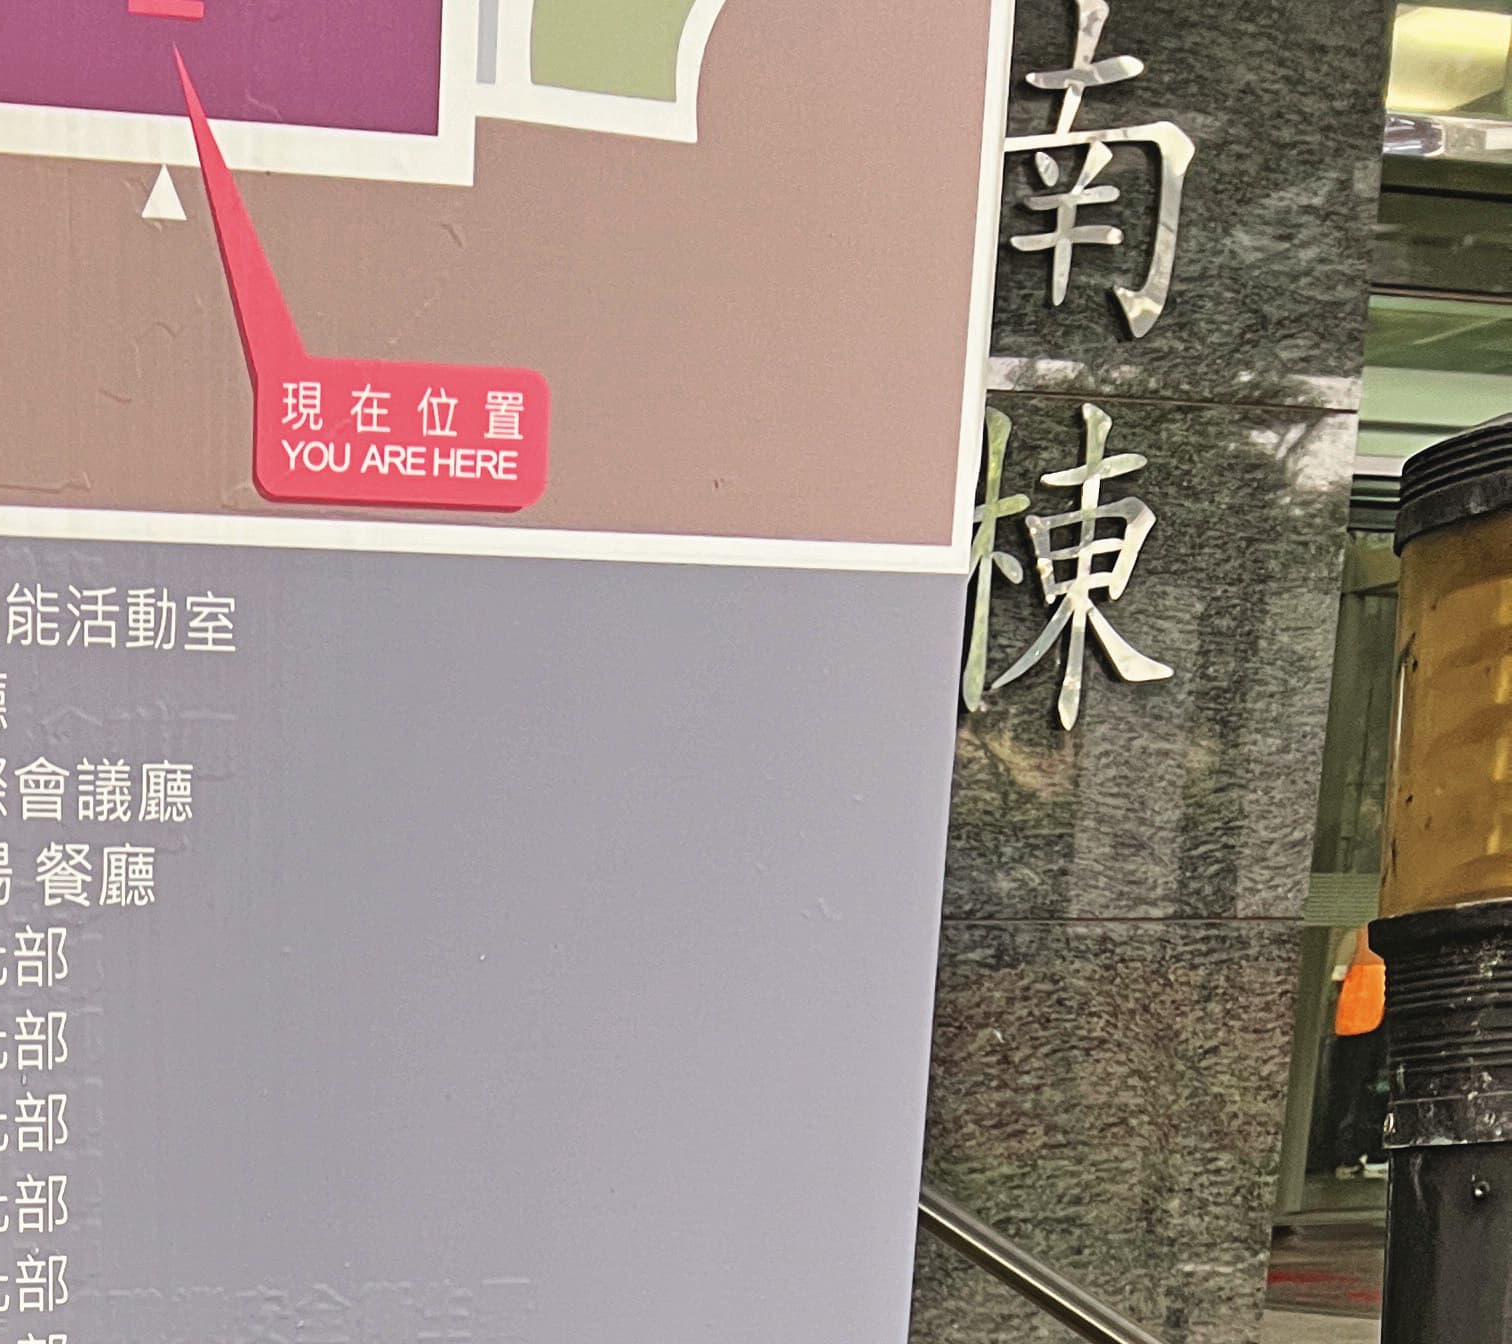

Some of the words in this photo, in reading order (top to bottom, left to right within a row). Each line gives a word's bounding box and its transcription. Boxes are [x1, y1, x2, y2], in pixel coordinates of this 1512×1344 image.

[962, 0, 1195, 730] 南棟
[282, 381, 524, 440] 現在位置
[282, 440, 351, 473] YOU
[360, 444, 427, 476] ARE
[433, 448, 519, 480] HERE
[36, 842, 155, 906] 餐廳
